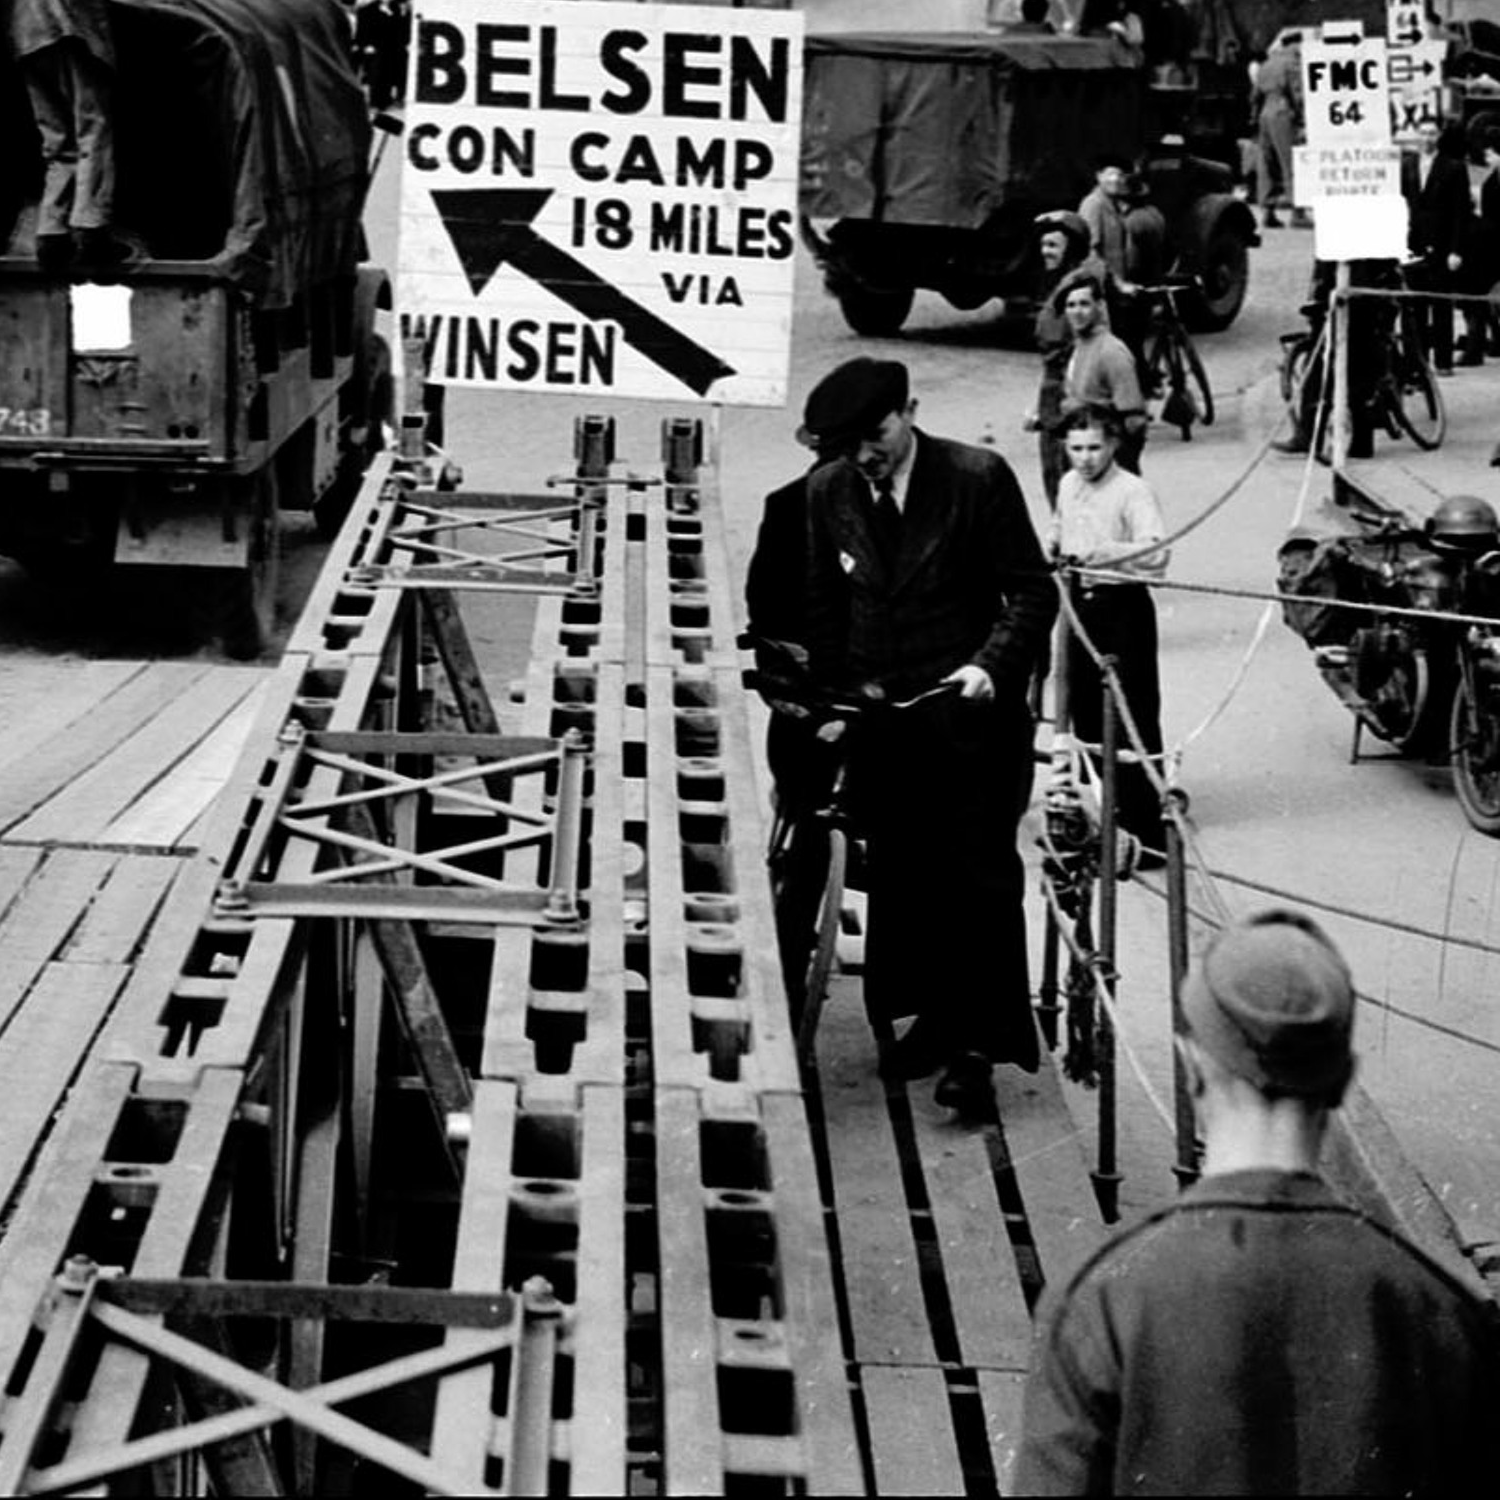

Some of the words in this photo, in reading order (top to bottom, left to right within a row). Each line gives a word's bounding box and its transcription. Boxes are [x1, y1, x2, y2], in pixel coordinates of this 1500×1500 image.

[414, 19, 790, 123] BELSEN
[1308, 61, 1379, 92] FMC
[1328, 101, 1365, 125] 64
[407, 123, 535, 177] CON
[569, 132, 774, 190] CAMP
[572, 197, 633, 250] 18
[650, 202, 794, 260] MILES
[661, 272, 744, 307] VIA
